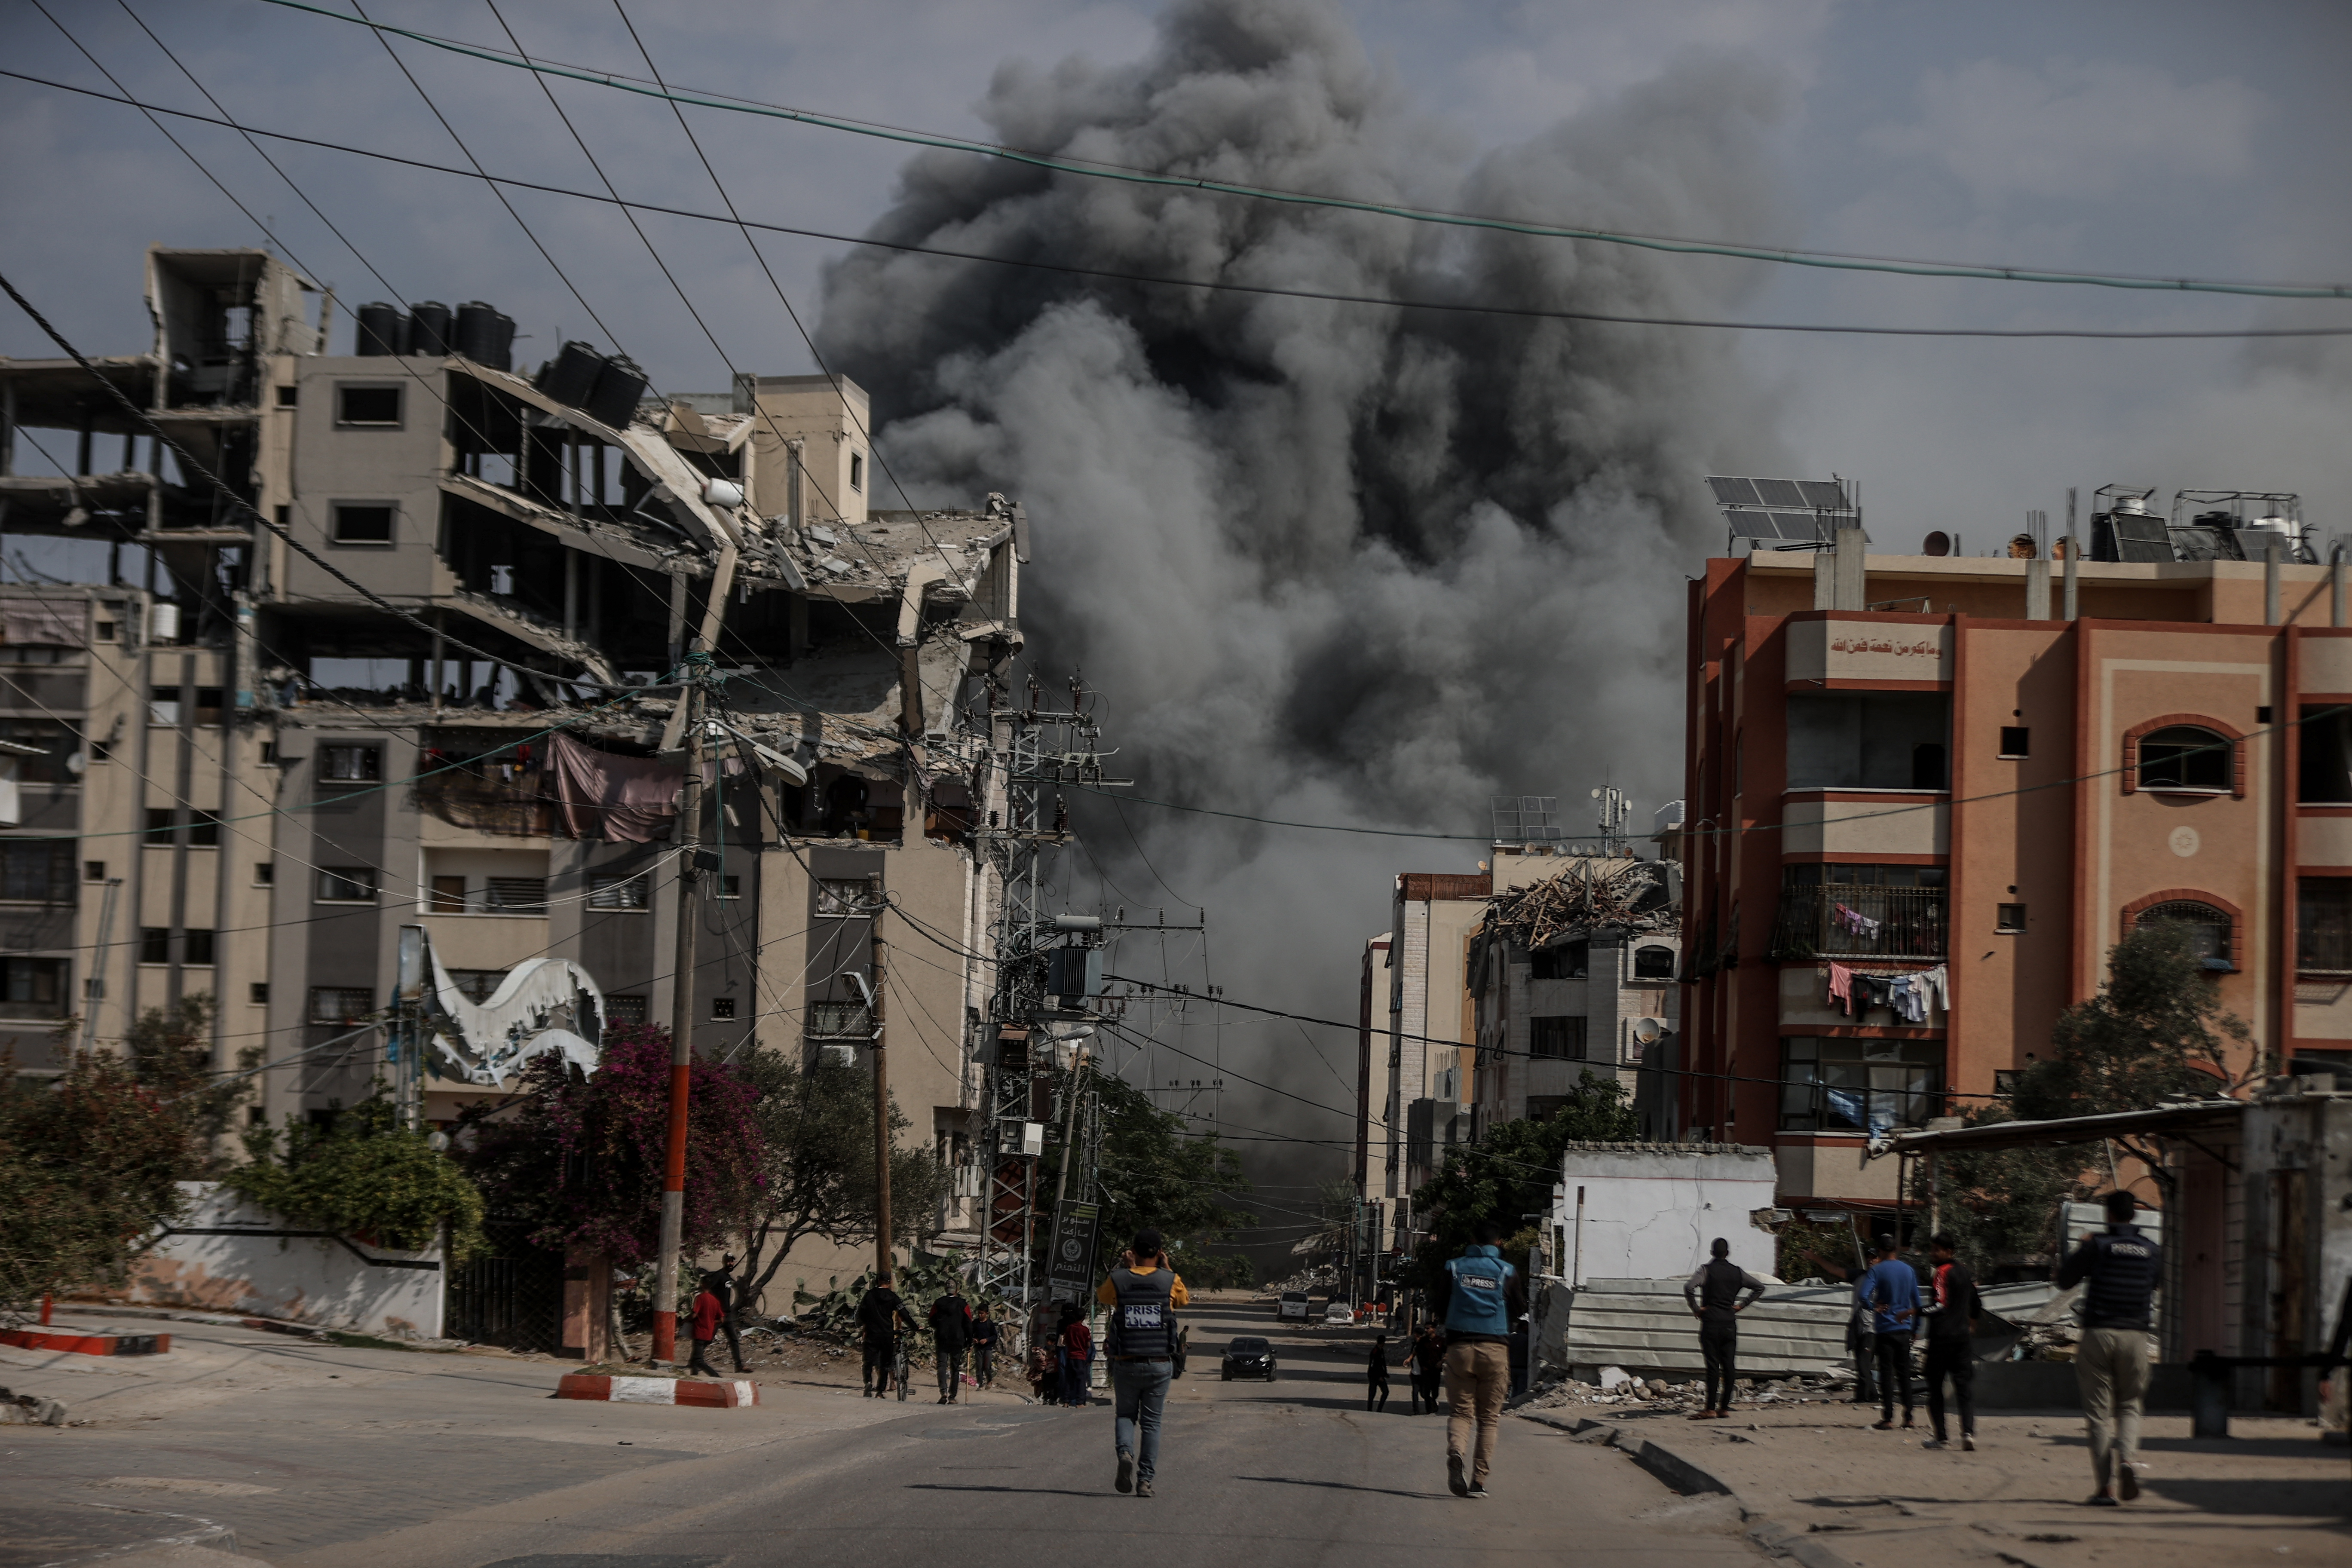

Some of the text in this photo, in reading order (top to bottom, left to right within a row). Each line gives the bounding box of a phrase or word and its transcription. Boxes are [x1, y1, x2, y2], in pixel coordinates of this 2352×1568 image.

[1830, 638, 1846, 652] الله
[1847, 637, 1868, 654] فمن
[1869, 638, 1892, 653] نعمة
[1894, 641, 1908, 656] من
[1926, 640, 1942, 659] وما
[1061, 1228, 1088, 1238] ماركت
[2111, 1243, 2150, 1258] PRESS
[1471, 1278, 1494, 1289] PRESS
[1125, 1317, 1162, 1327] صحافة
